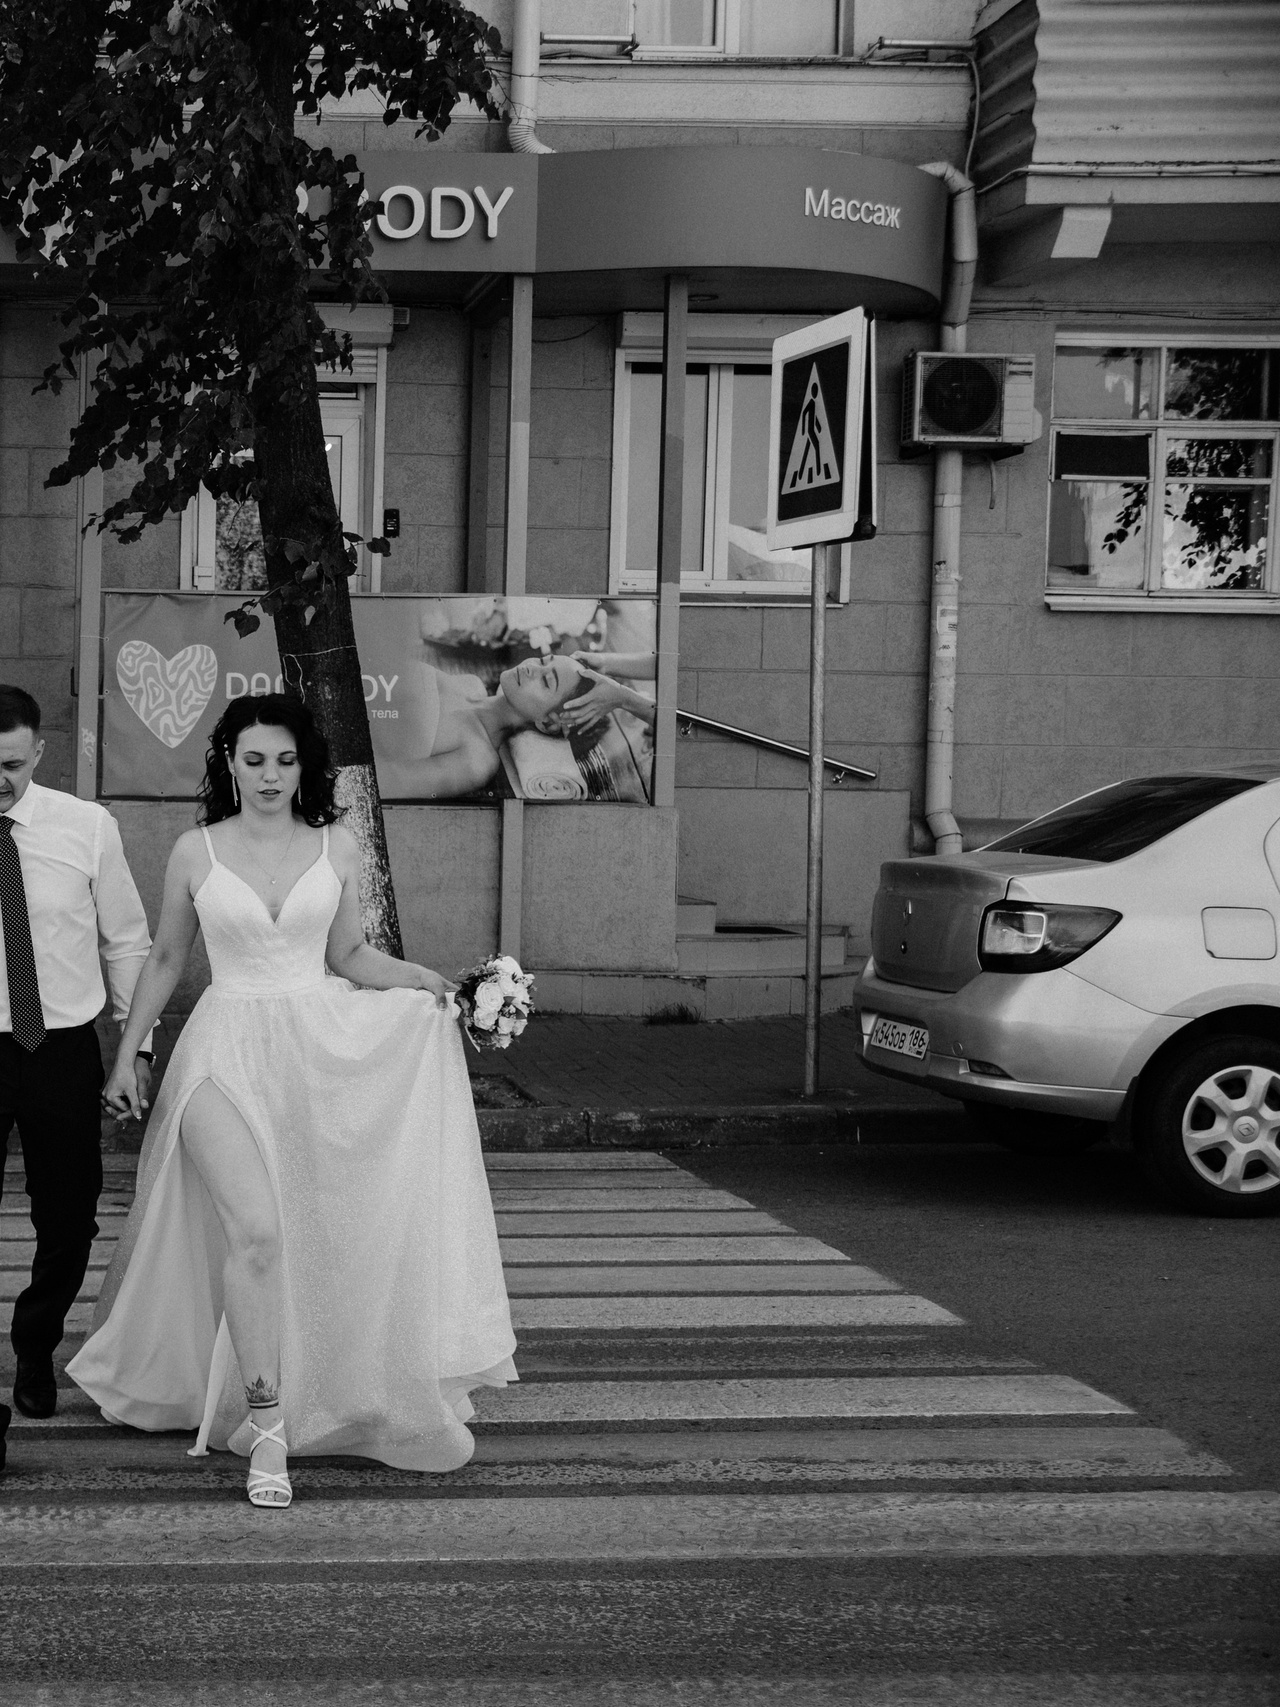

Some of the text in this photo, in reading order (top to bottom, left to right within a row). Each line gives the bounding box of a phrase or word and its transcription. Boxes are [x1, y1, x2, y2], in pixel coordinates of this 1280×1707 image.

[357, 184, 515, 239] ODY
[804, 186, 901, 229] Массаж
[360, 674, 399, 702] DY
[371, 709, 399, 719] тела
[908, 1029, 927, 1049] 186
